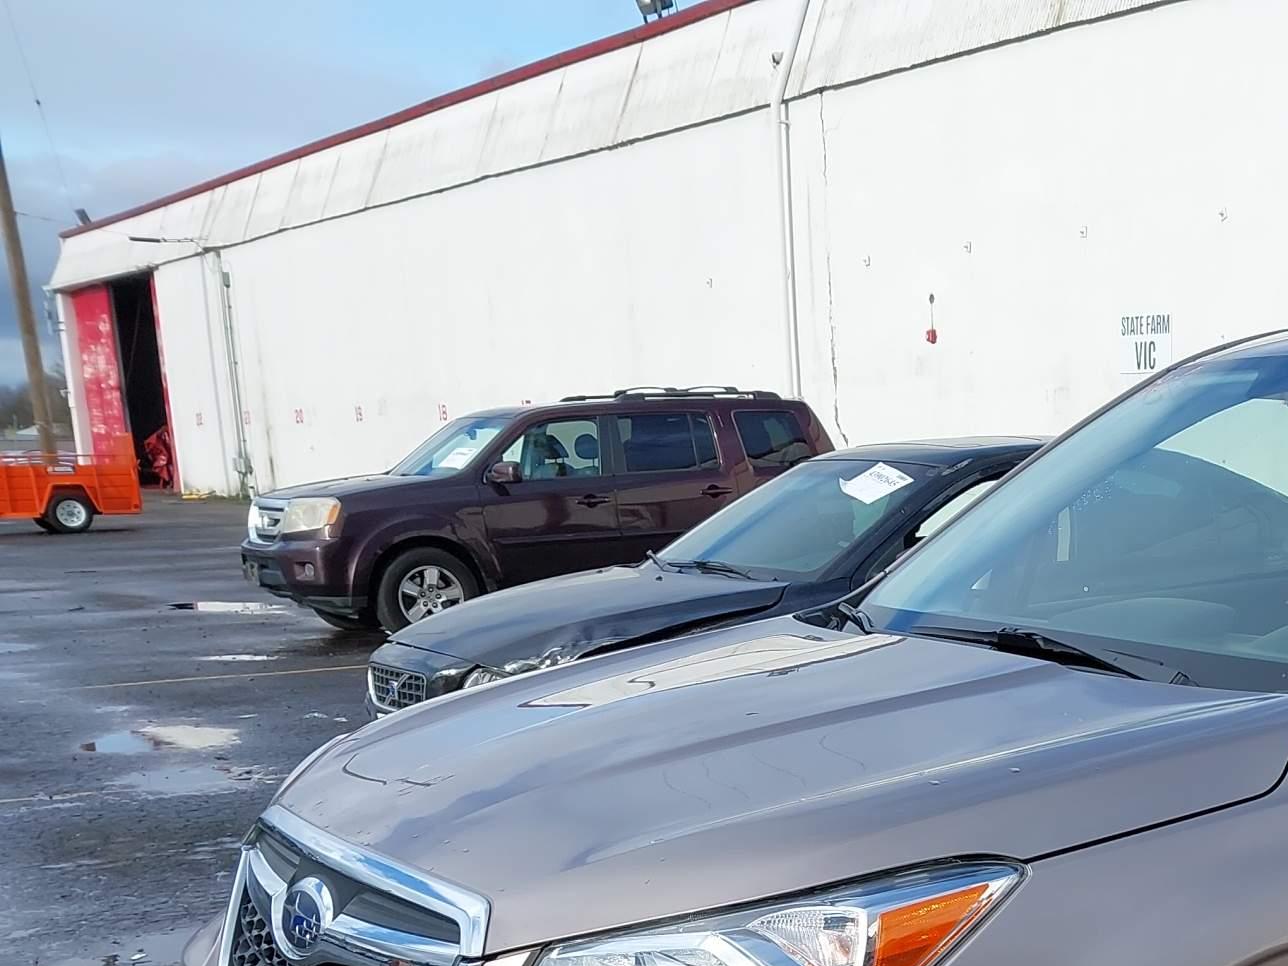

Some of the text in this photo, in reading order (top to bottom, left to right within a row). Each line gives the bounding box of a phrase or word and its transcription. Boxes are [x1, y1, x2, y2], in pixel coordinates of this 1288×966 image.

[1121, 314, 1170, 336] STATE FARM
[1134, 340, 1156, 370] VIC
[438, 403, 448, 421] 18
